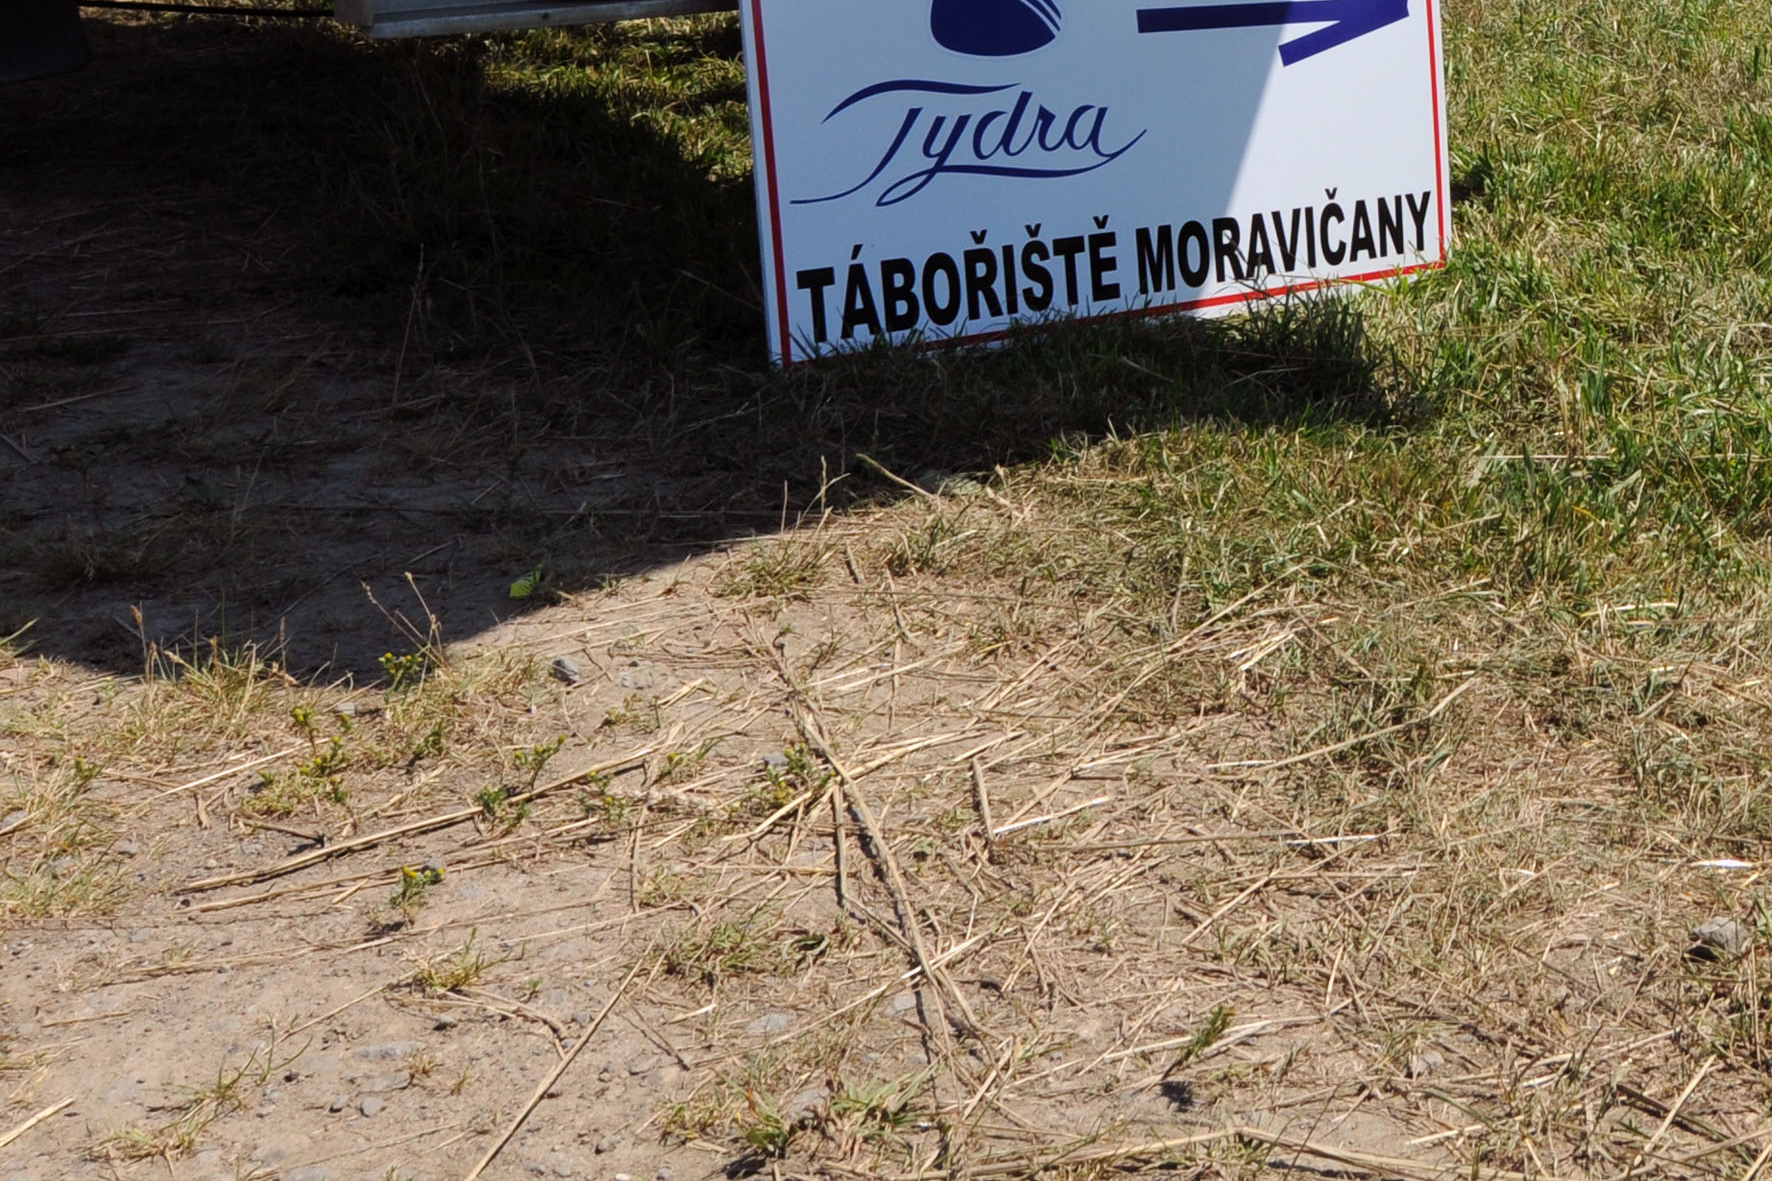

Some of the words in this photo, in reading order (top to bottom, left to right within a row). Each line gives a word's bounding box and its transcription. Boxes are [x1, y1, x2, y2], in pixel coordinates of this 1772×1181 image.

[790, 79, 1147, 207] Tydra
[797, 215, 1120, 343] TÁBOŘIŠTĚ
[1136, 188, 1432, 294] MORAVIČANY
